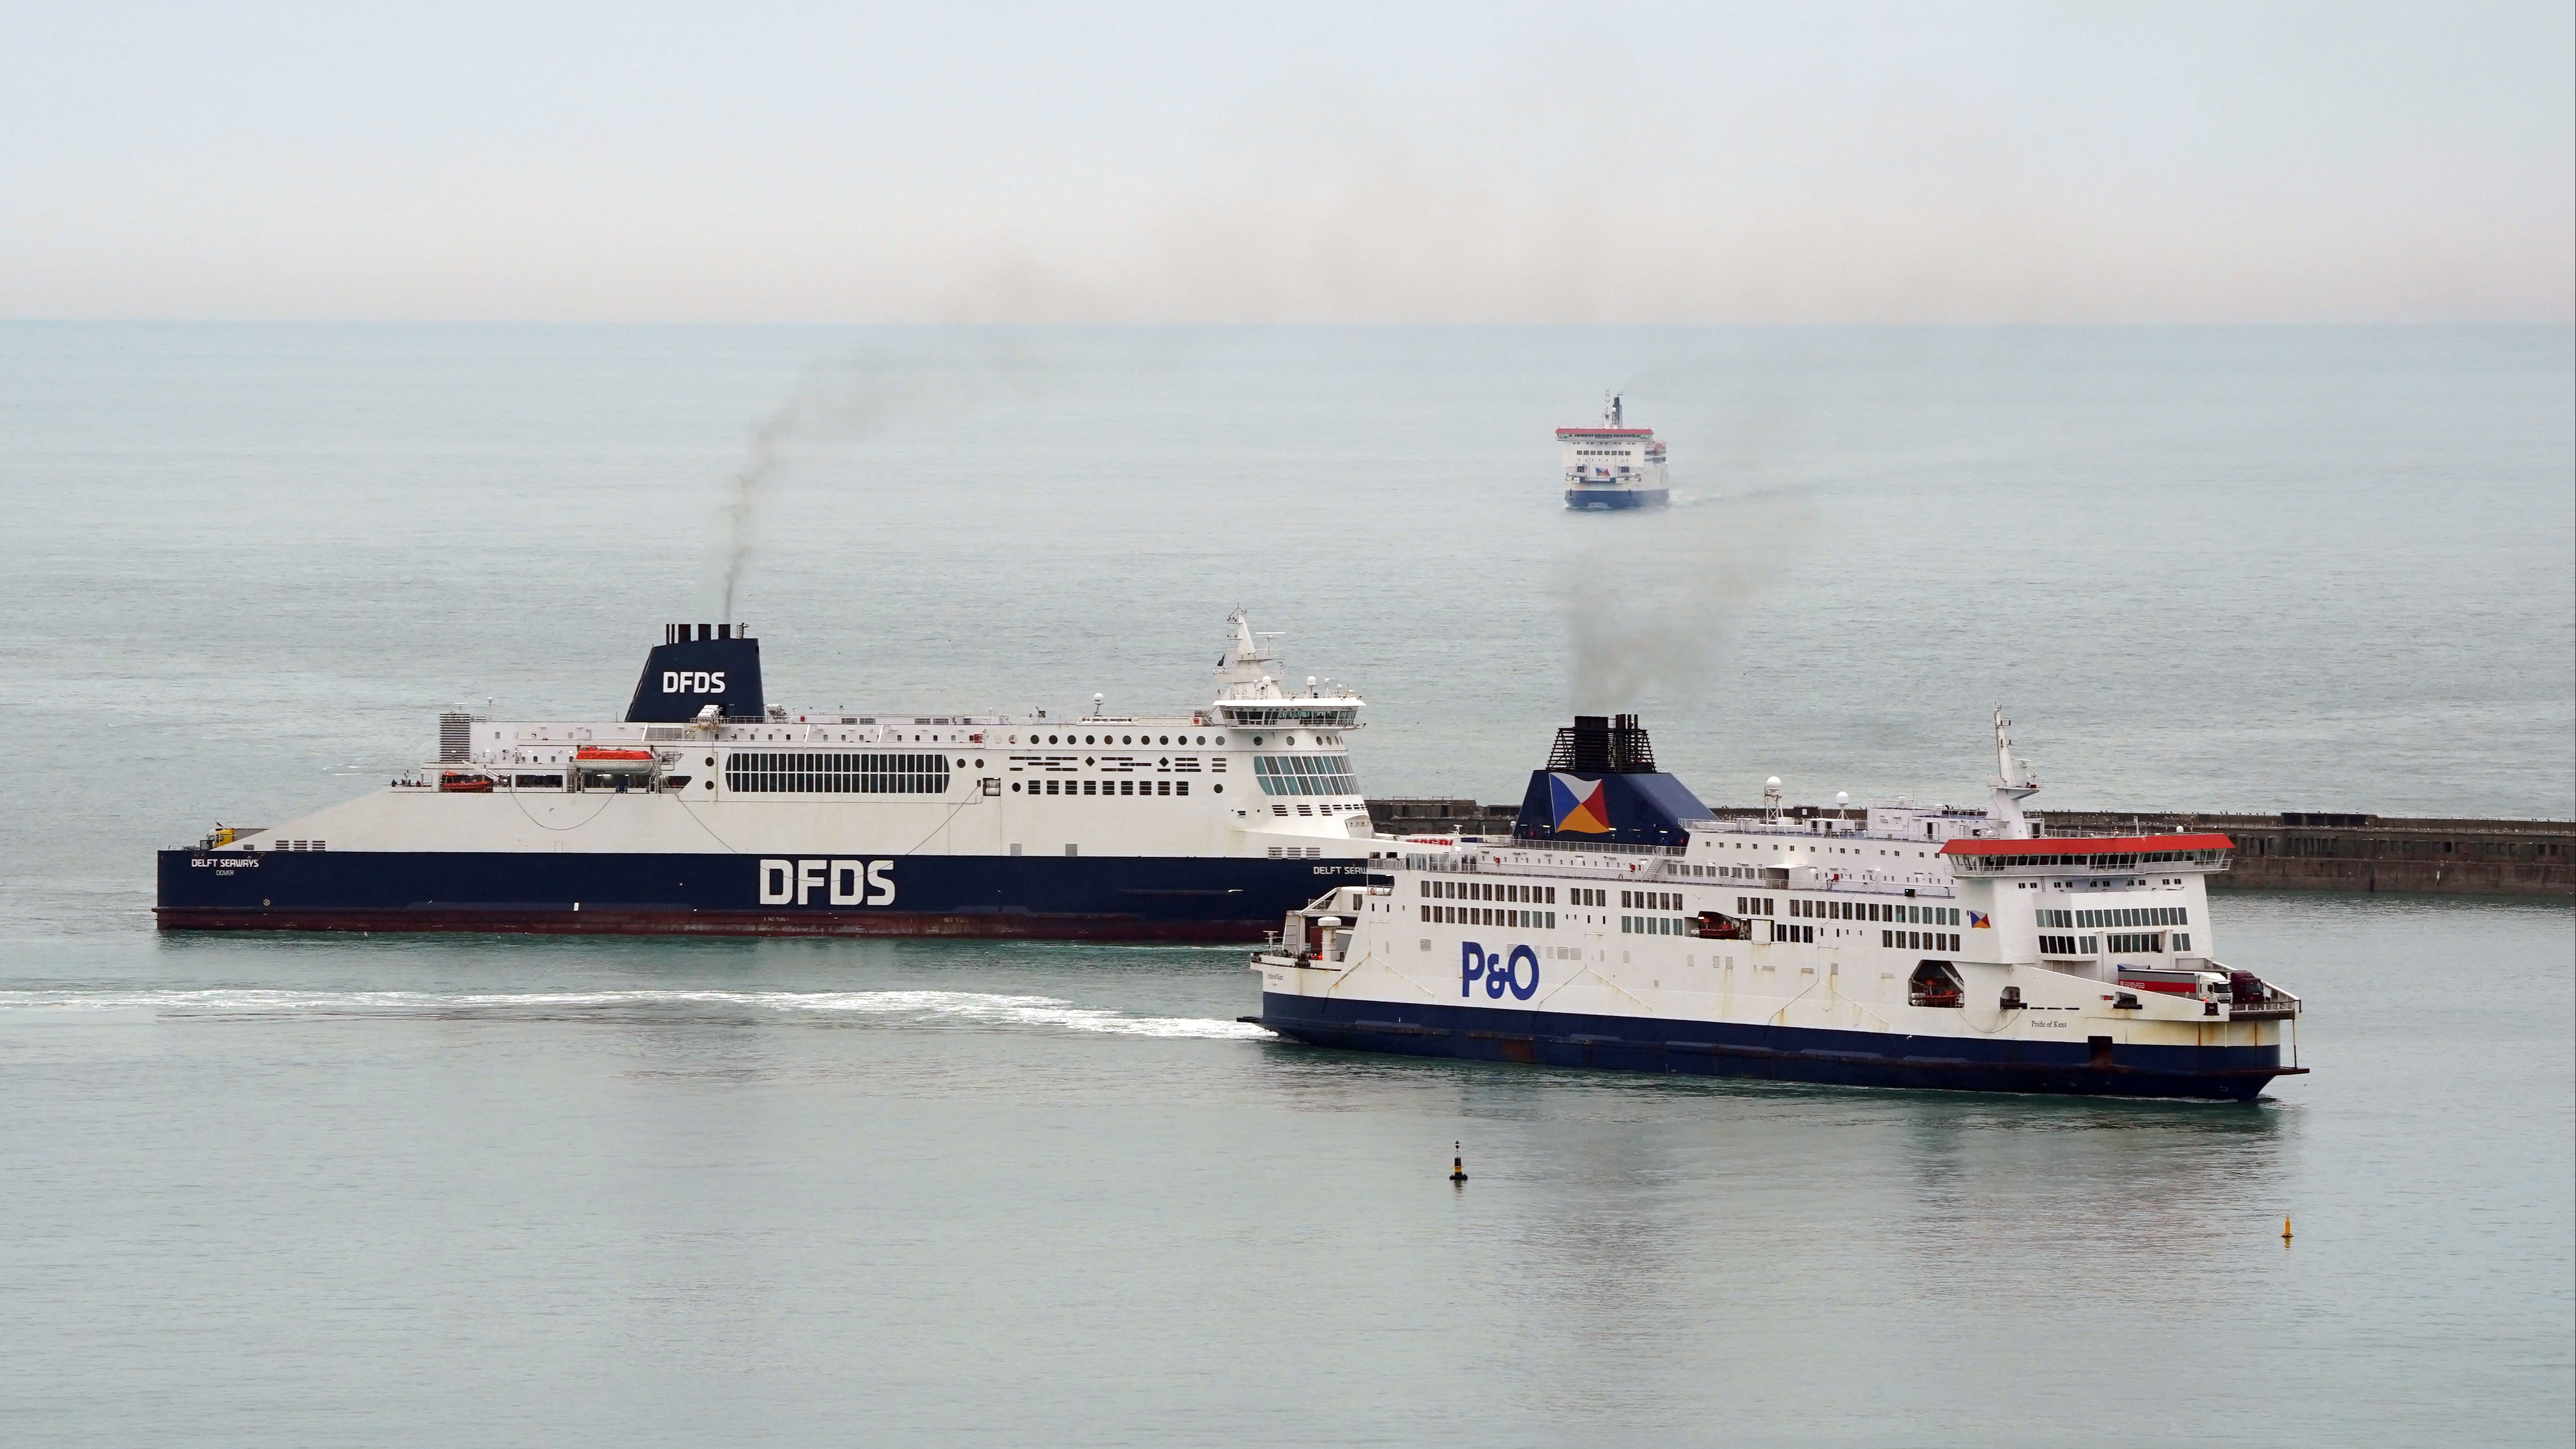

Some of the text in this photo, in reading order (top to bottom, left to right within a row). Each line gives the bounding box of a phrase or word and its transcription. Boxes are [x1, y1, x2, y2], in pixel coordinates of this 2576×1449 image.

[663, 671, 725, 693] DFDS
[191, 859, 260, 868] DELFT SEAWAYS
[1313, 866, 1341, 874] DELFT
[760, 859, 895, 905] DFDS
[1462, 941, 1540, 1000] P&O
